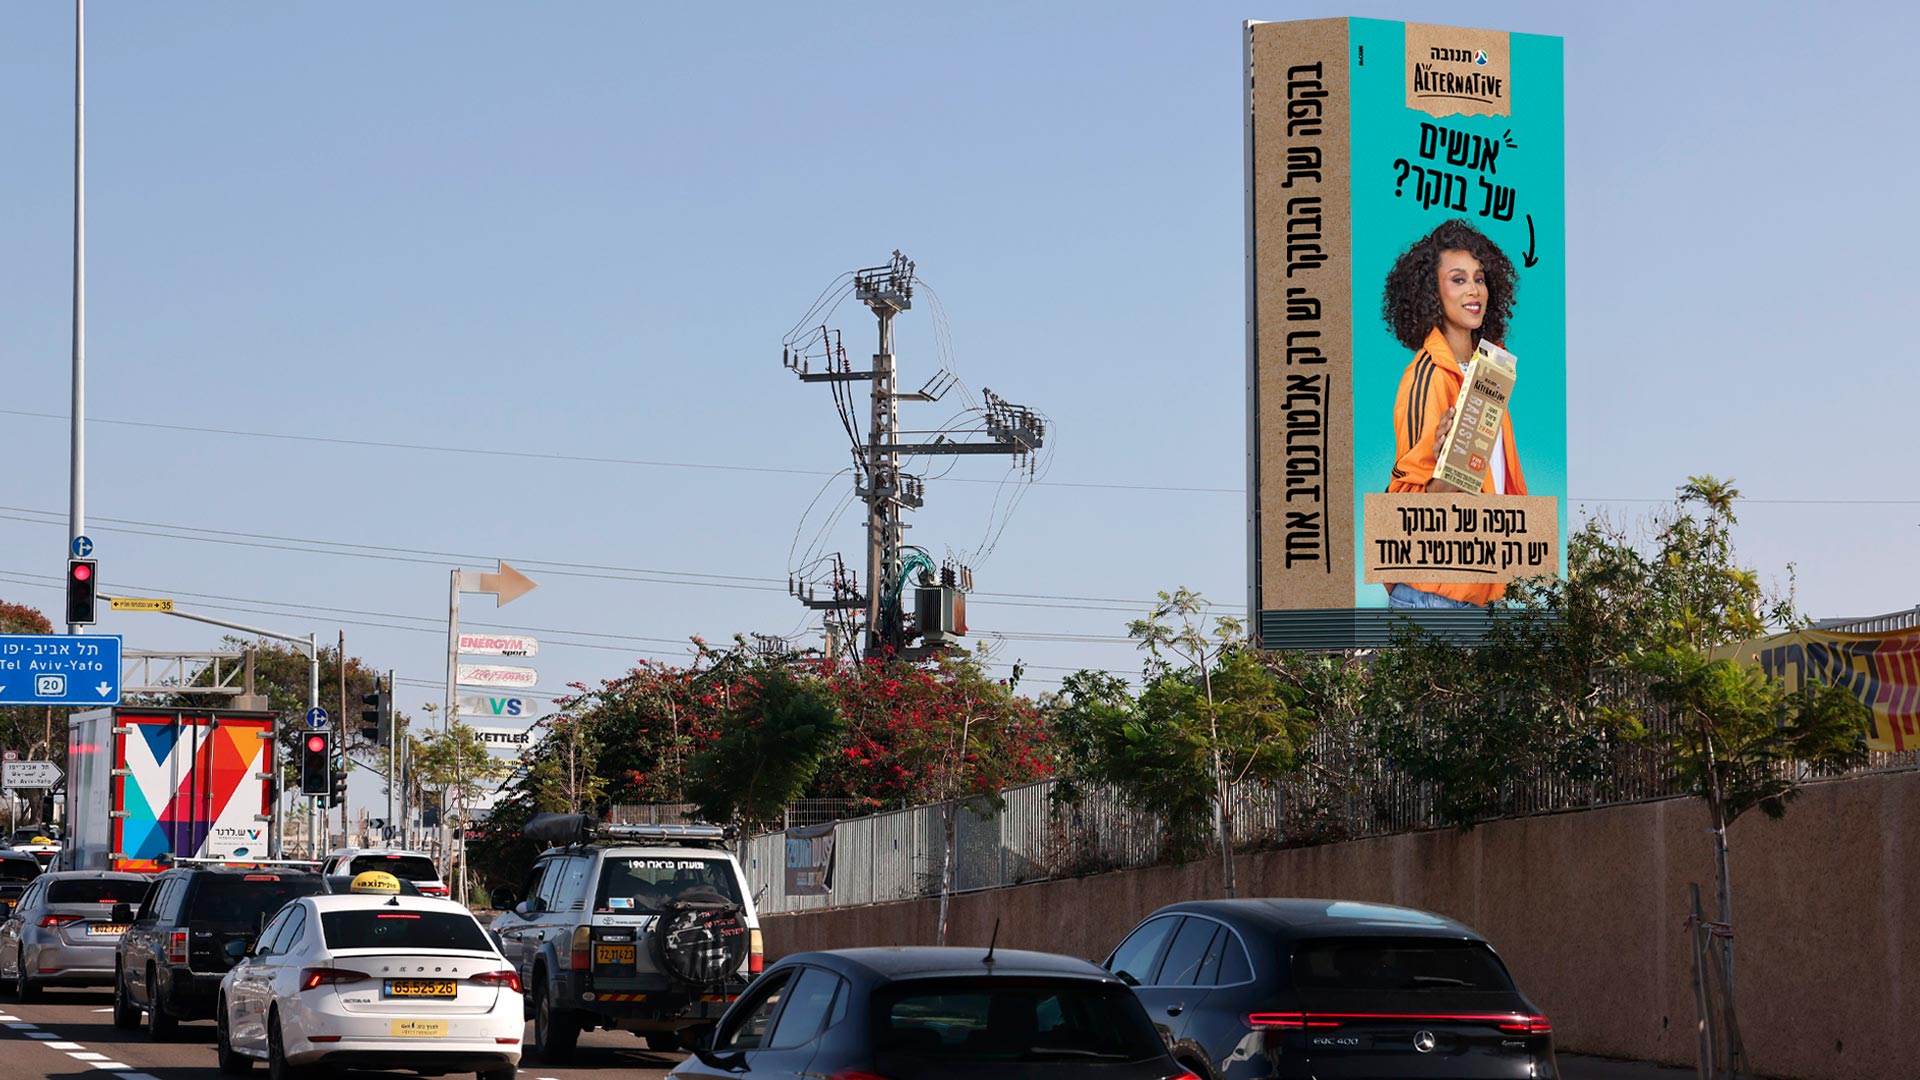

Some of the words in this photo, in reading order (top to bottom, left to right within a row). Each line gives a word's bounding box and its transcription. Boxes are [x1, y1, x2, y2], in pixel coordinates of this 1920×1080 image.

[1430, 47, 1472, 63] תנובה
[1287, 61, 1329, 137] בקפה
[1419, 122, 1500, 175] אנשים
[1281, 146, 1322, 188] של
[1393, 159, 1467, 213] בוקר?
[1479, 175, 1516, 222] של
[1286, 197, 1328, 278] הבוקר
[1286, 287, 1322, 321] יש
[1286, 331, 1327, 365] רק
[1281, 374, 1321, 502] אלטרנטיב
[1453, 395, 1483, 456] BARISTA
[1397, 506, 1447, 536] הבוקר
[1452, 504, 1477, 533] של
[1483, 508, 1527, 538] בקפה
[1285, 512, 1320, 569] אחד
[1375, 539, 1411, 565] אחד
[1417, 537, 1496, 566] אלטרנטיב
[1528, 542, 1548, 566] יש
[1501, 541, 1522, 570] רק
[161, 601, 171, 610] 35
[3, 643, 70, 656] אביב-יפו
[77, 641, 98, 655] תל
[460, 637, 523, 651] ENERGYM
[0, 660, 20, 670] Tel
[29, 660, 103, 671] Aviv-Yafo
[43, 679, 58, 691] 20
[474, 732, 530, 744] KETTLER
[1337, 1037, 1359, 1046] 400
